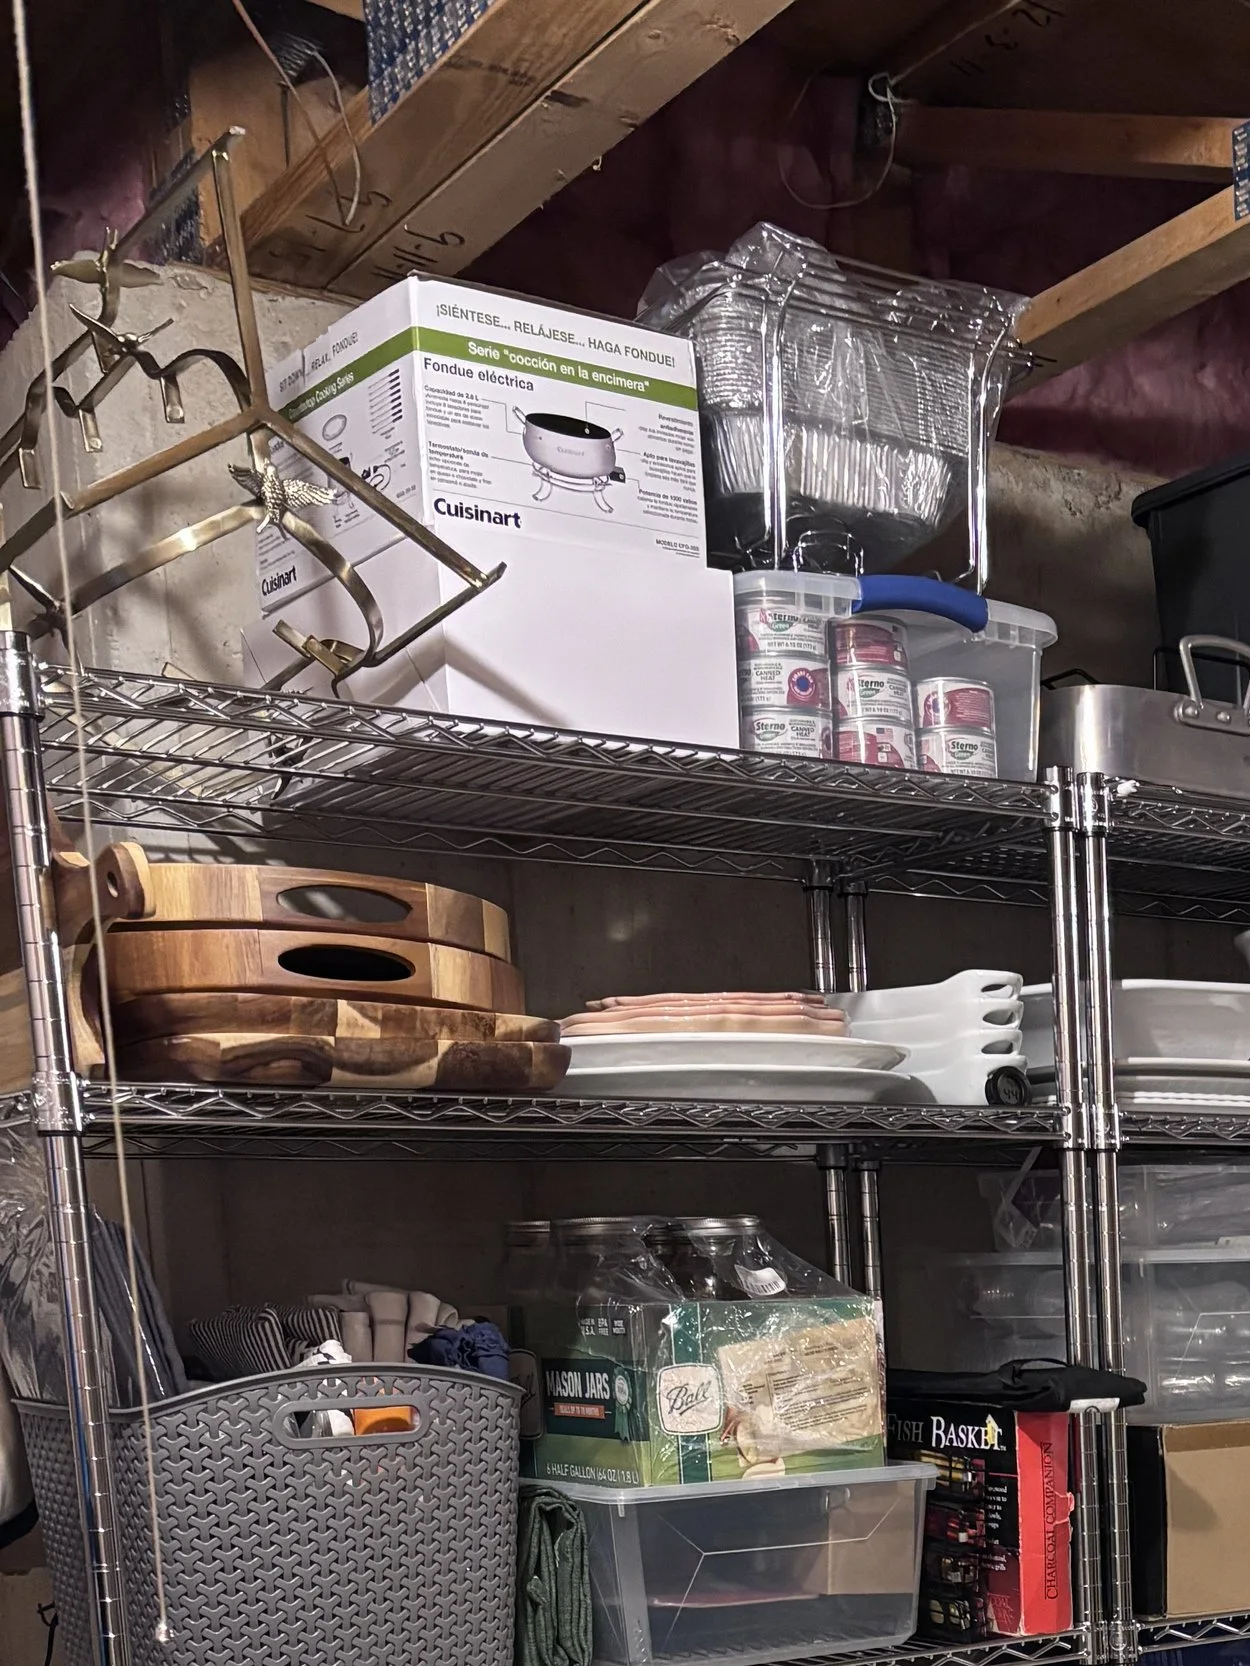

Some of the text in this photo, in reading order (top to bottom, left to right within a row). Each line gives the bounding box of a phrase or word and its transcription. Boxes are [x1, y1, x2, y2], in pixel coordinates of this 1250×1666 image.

[468, 341, 500, 361] Serie
[560, 364, 575, 377] en
[578, 364, 589, 380] la
[588, 337, 621, 355] HAGA
[624, 346, 675, 368] FONDUE!
[423, 358, 534, 392] Fondue eléctrica
[433, 498, 522, 530] Cuisinart
[261, 565, 297, 597] Cuisinart
[755, 721, 786, 731] Sterno
[951, 741, 979, 751] Sterno
[545, 1371, 583, 1398] MASON
[584, 1372, 610, 1400] JARS
[666, 1380, 712, 1416] Ball
[887, 1413, 1004, 1451] FISH BASKET
[551, 1464, 569, 1477] HALF
[570, 1466, 596, 1480] GALLON
[607, 1470, 617, 1482] OZ
[1042, 1442, 1058, 1600] CHARCOAL COMPANION
